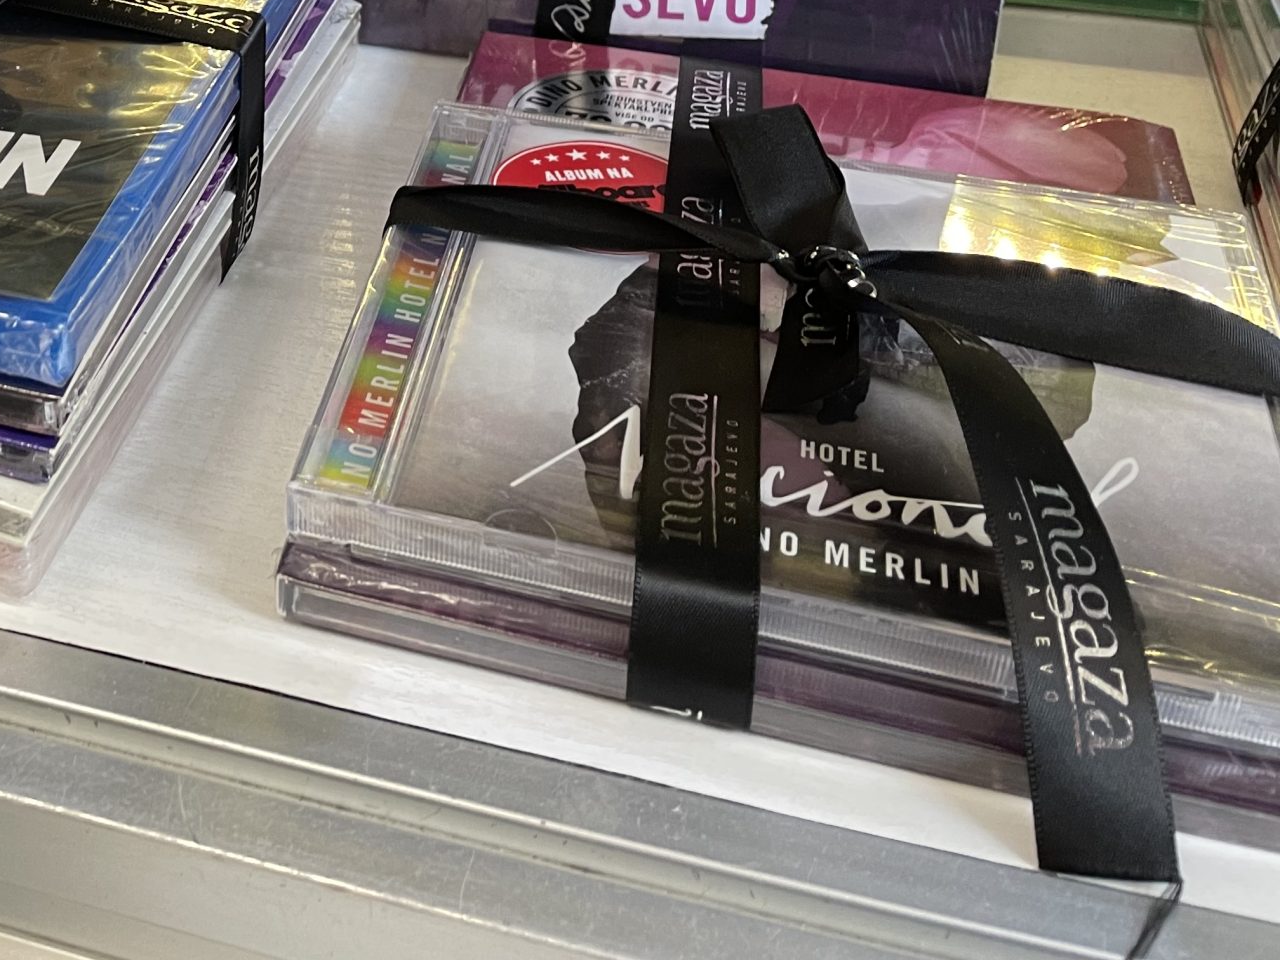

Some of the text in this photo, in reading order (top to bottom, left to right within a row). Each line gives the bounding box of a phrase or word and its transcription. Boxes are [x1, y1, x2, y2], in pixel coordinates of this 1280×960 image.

[526, 78, 583, 108] DINO
[544, 167, 634, 183] ALBUM NA
[358, 333, 415, 429] MERLIN
[394, 257, 440, 324] HOTEL
[660, 392, 720, 546] magaza
[723, 419, 739, 525] SARAJEVO
[801, 439, 885, 473] HOTEL
[824, 539, 980, 596] MERLIN
[1008, 511, 1060, 703] SARAJEVO
[1029, 478, 1135, 756] magaza
